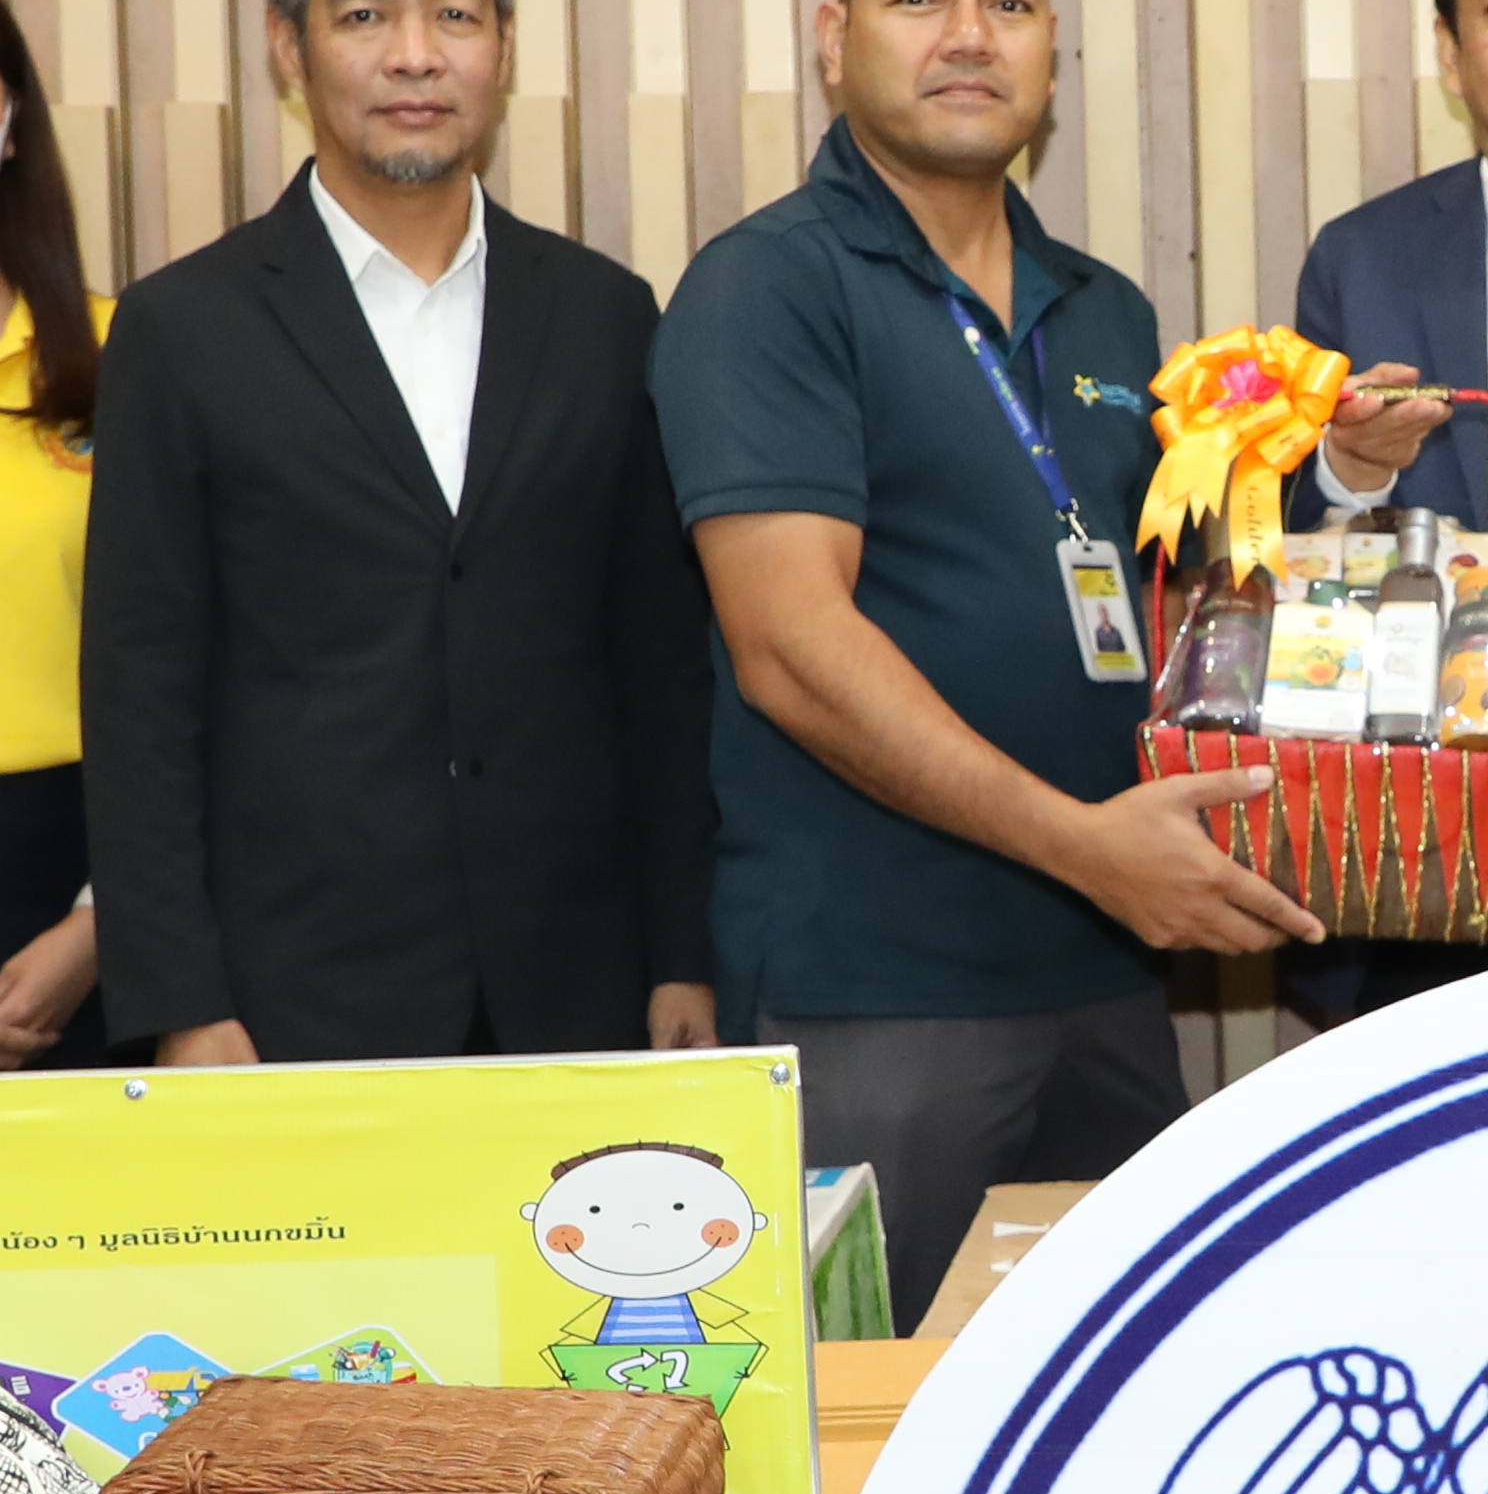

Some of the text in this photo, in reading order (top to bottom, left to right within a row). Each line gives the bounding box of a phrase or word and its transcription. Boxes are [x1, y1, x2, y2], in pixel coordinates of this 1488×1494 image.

[98, 1216, 346, 1253] มูลนิธิบ้านนกขมิ้น
